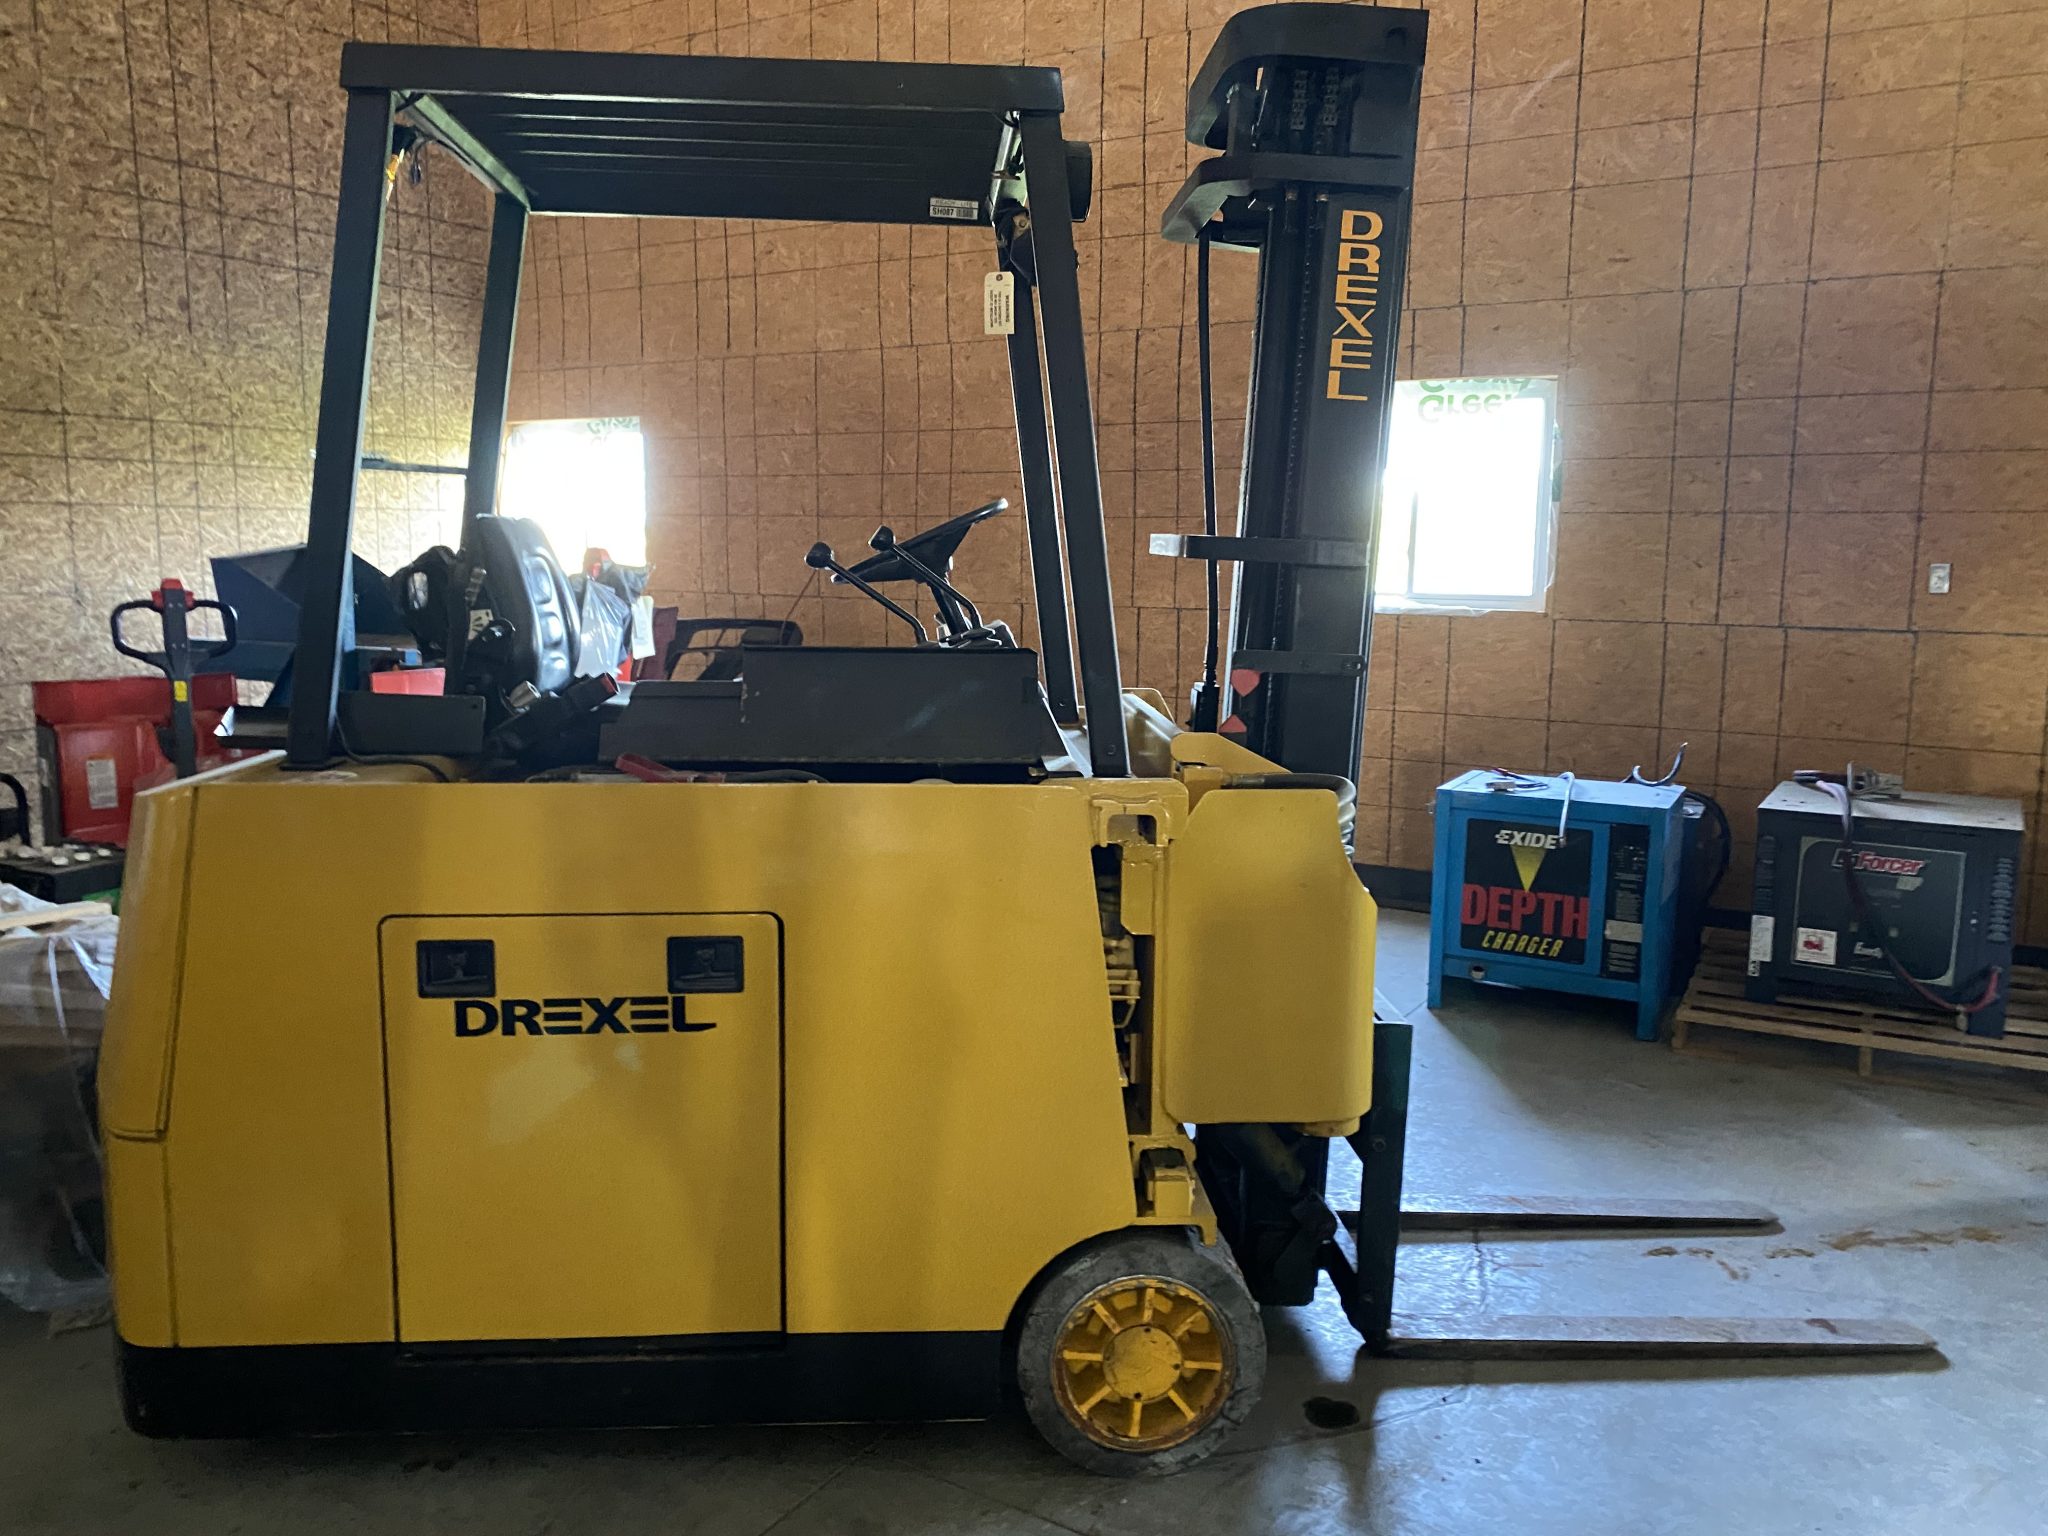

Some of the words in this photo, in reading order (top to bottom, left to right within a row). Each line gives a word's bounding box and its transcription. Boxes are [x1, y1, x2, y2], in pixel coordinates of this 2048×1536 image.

[1326, 209, 1384, 401] DREXEL
[1495, 830, 1559, 849] EXIDE
[1461, 883, 1590, 939] DEPTH
[1482, 930, 1564, 957] CHARGER
[454, 995, 717, 1037] DREXEL
